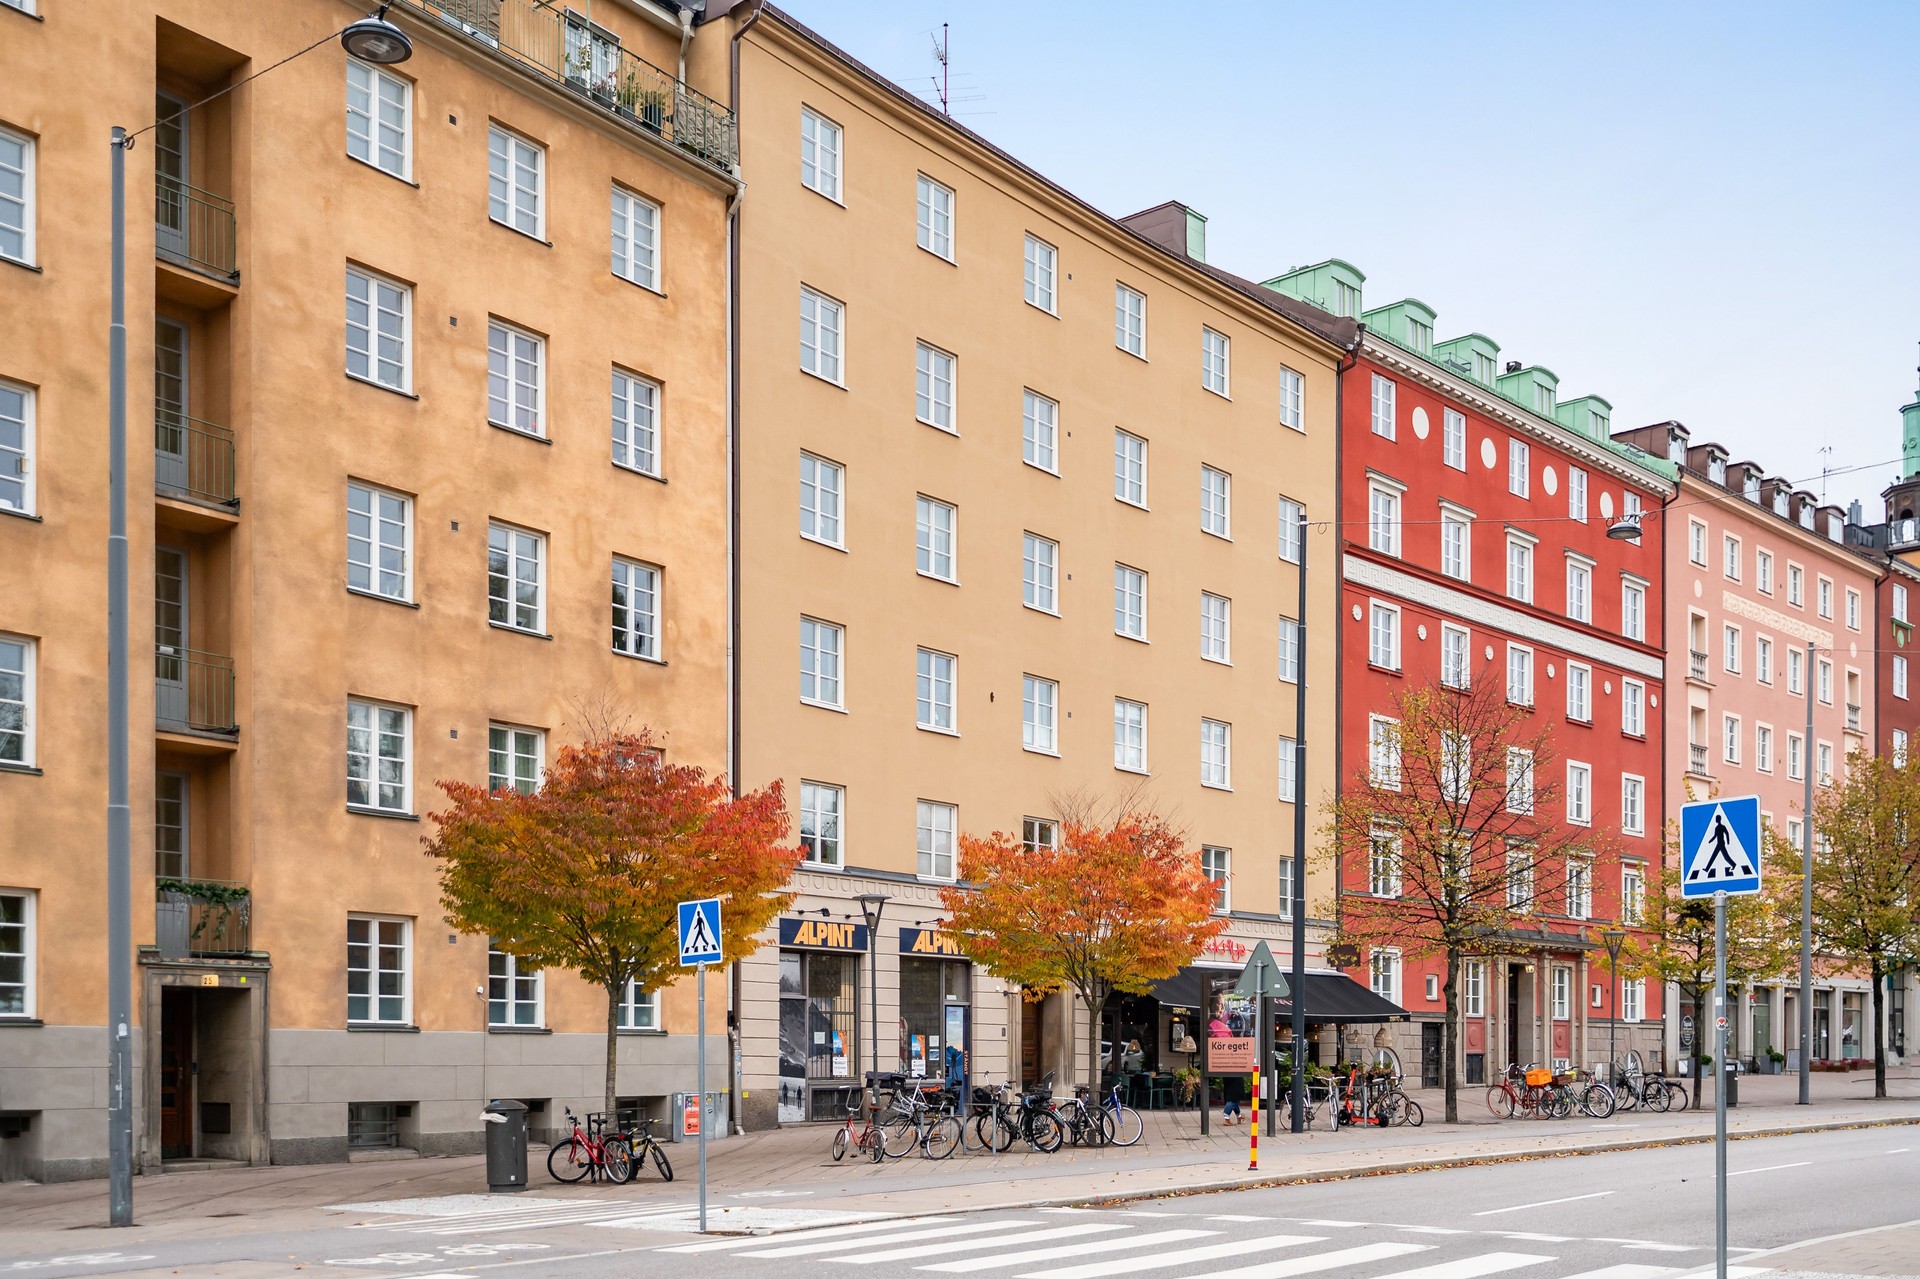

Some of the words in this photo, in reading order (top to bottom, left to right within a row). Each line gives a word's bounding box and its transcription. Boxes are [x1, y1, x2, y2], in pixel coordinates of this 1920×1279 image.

[793, 921, 855, 948] ALPINT
[1212, 1042, 1226, 1050] Kör
[1227, 1042, 1249, 1052] eget!
